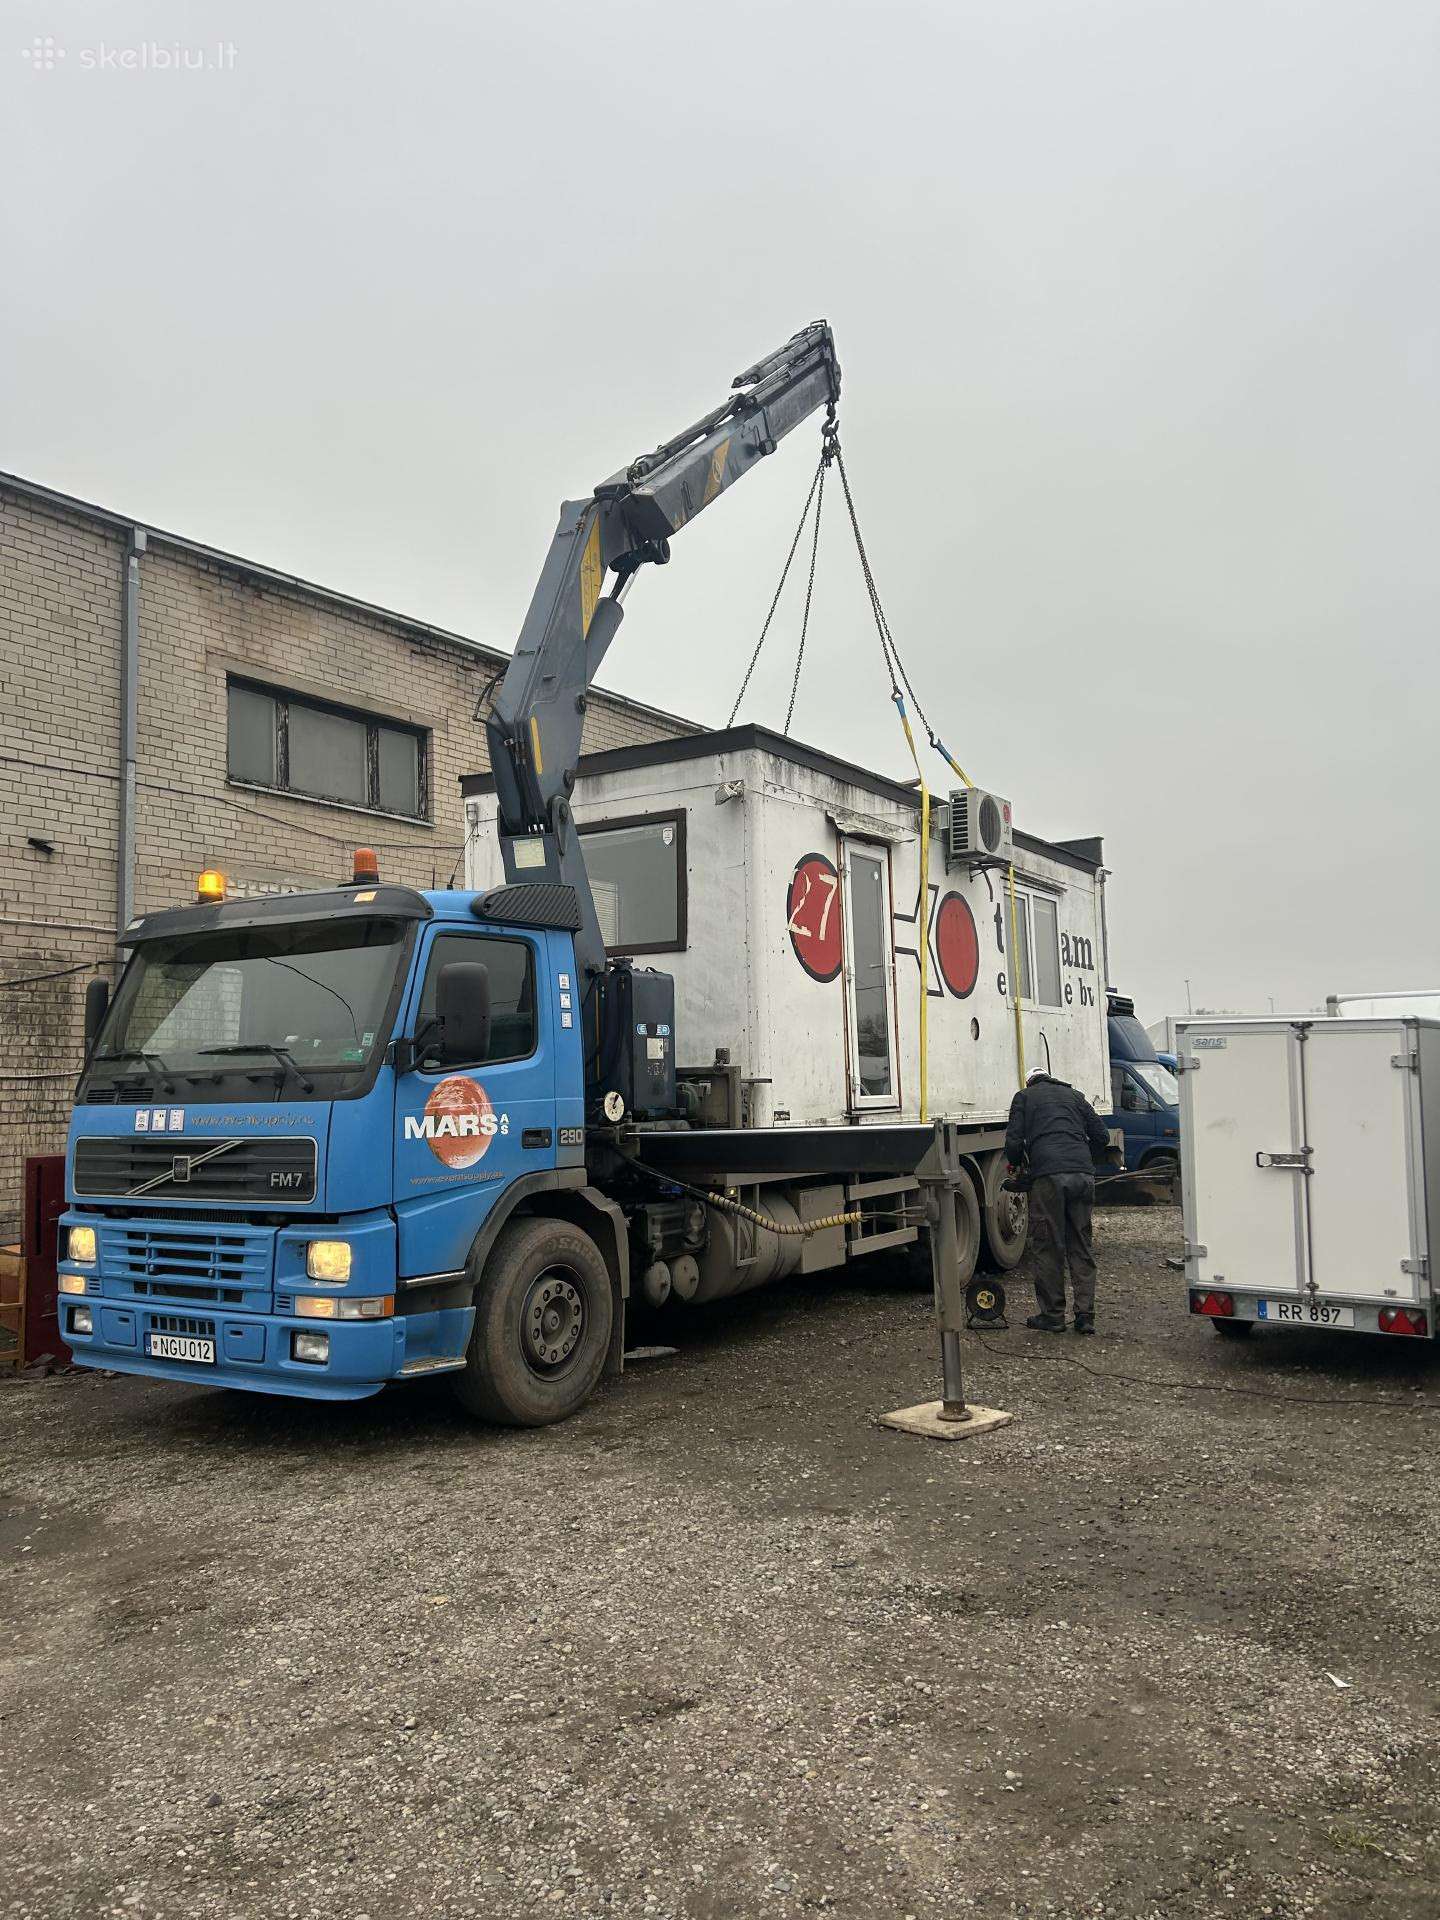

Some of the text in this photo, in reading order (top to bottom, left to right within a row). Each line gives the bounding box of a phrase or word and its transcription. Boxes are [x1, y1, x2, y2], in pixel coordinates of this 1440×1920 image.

[786, 871, 838, 941] 27
[404, 1113, 499, 1140] MARS
[560, 1129, 583, 1144] 290
[270, 1172, 303, 1187] FM7
[1279, 1304, 1341, 1323] RR 897
